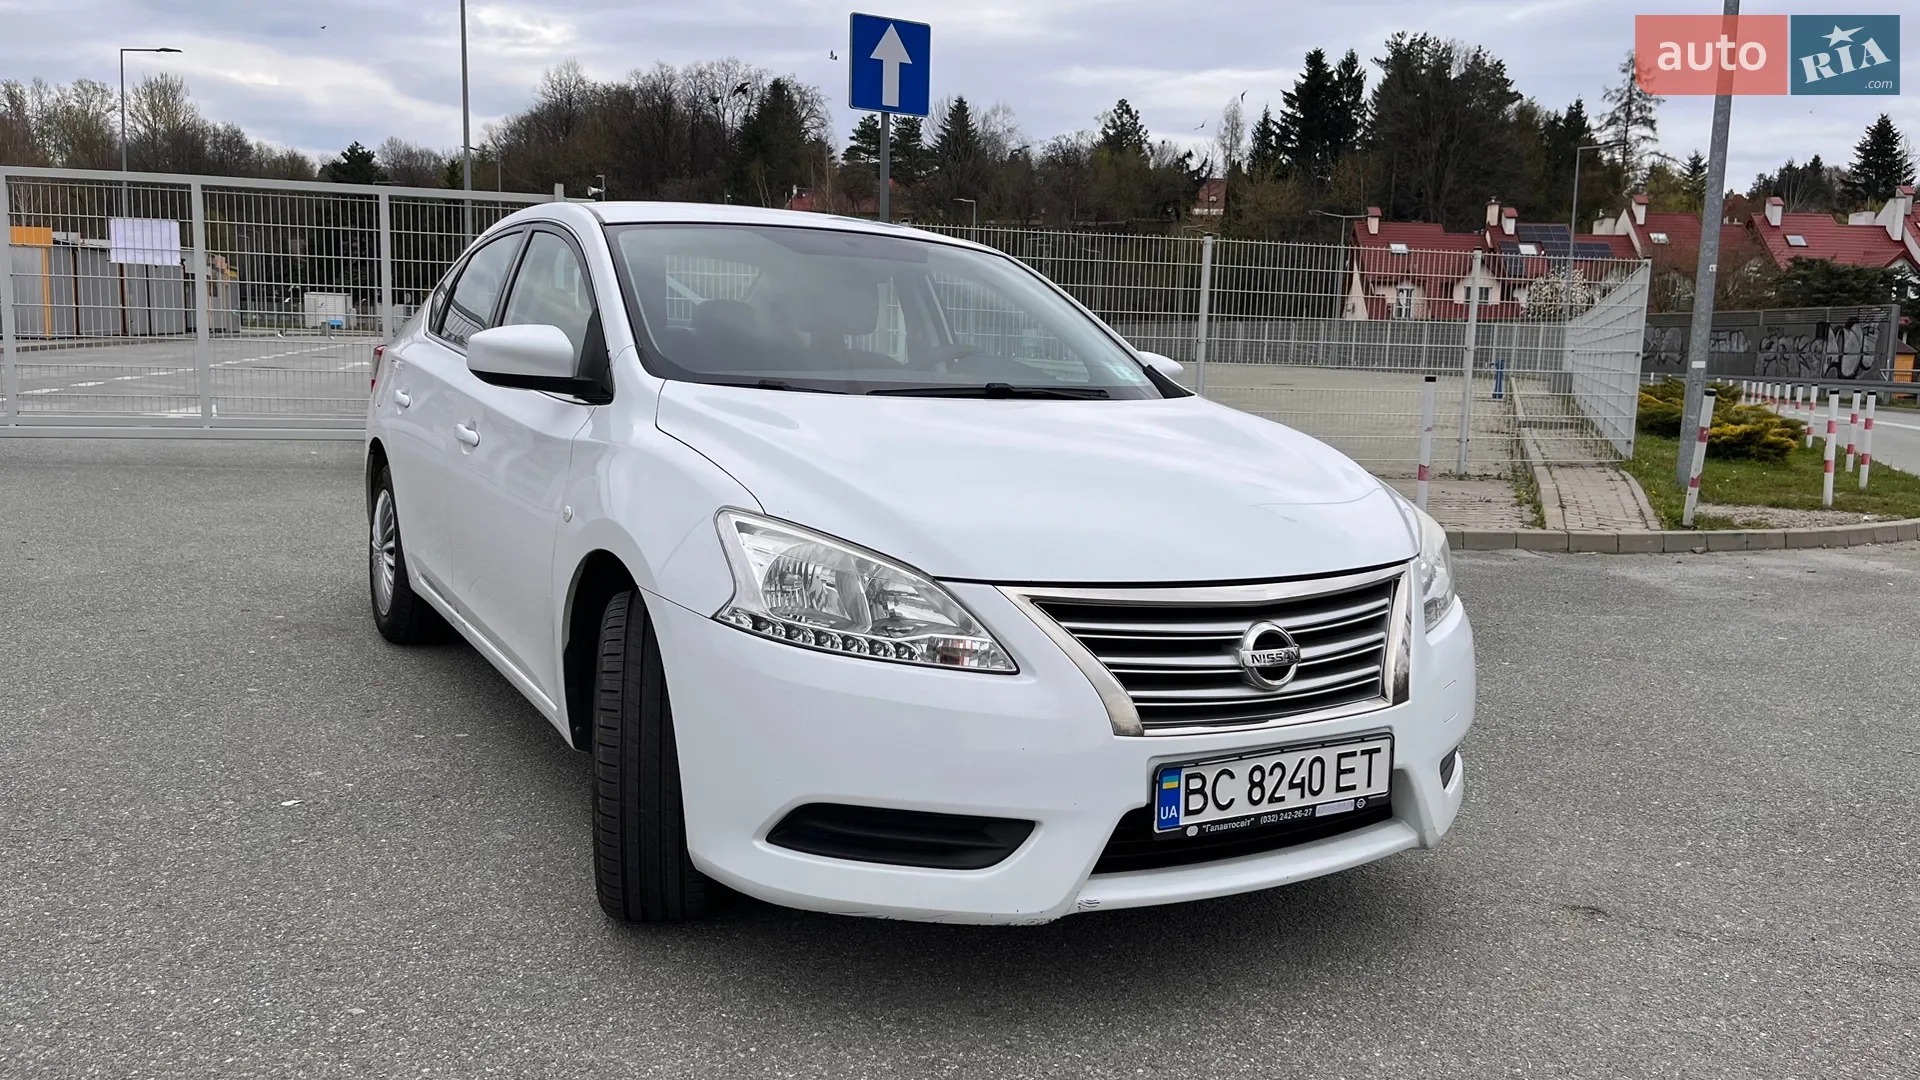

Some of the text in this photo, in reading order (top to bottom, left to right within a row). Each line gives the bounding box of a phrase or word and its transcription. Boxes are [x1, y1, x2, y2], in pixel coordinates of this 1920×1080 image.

[1251, 651, 1298, 664] NISSAN
[1184, 747, 1382, 817] BC 8240 ET
[1160, 805, 1178, 820] UA
[1260, 811, 1278, 825] (032)
